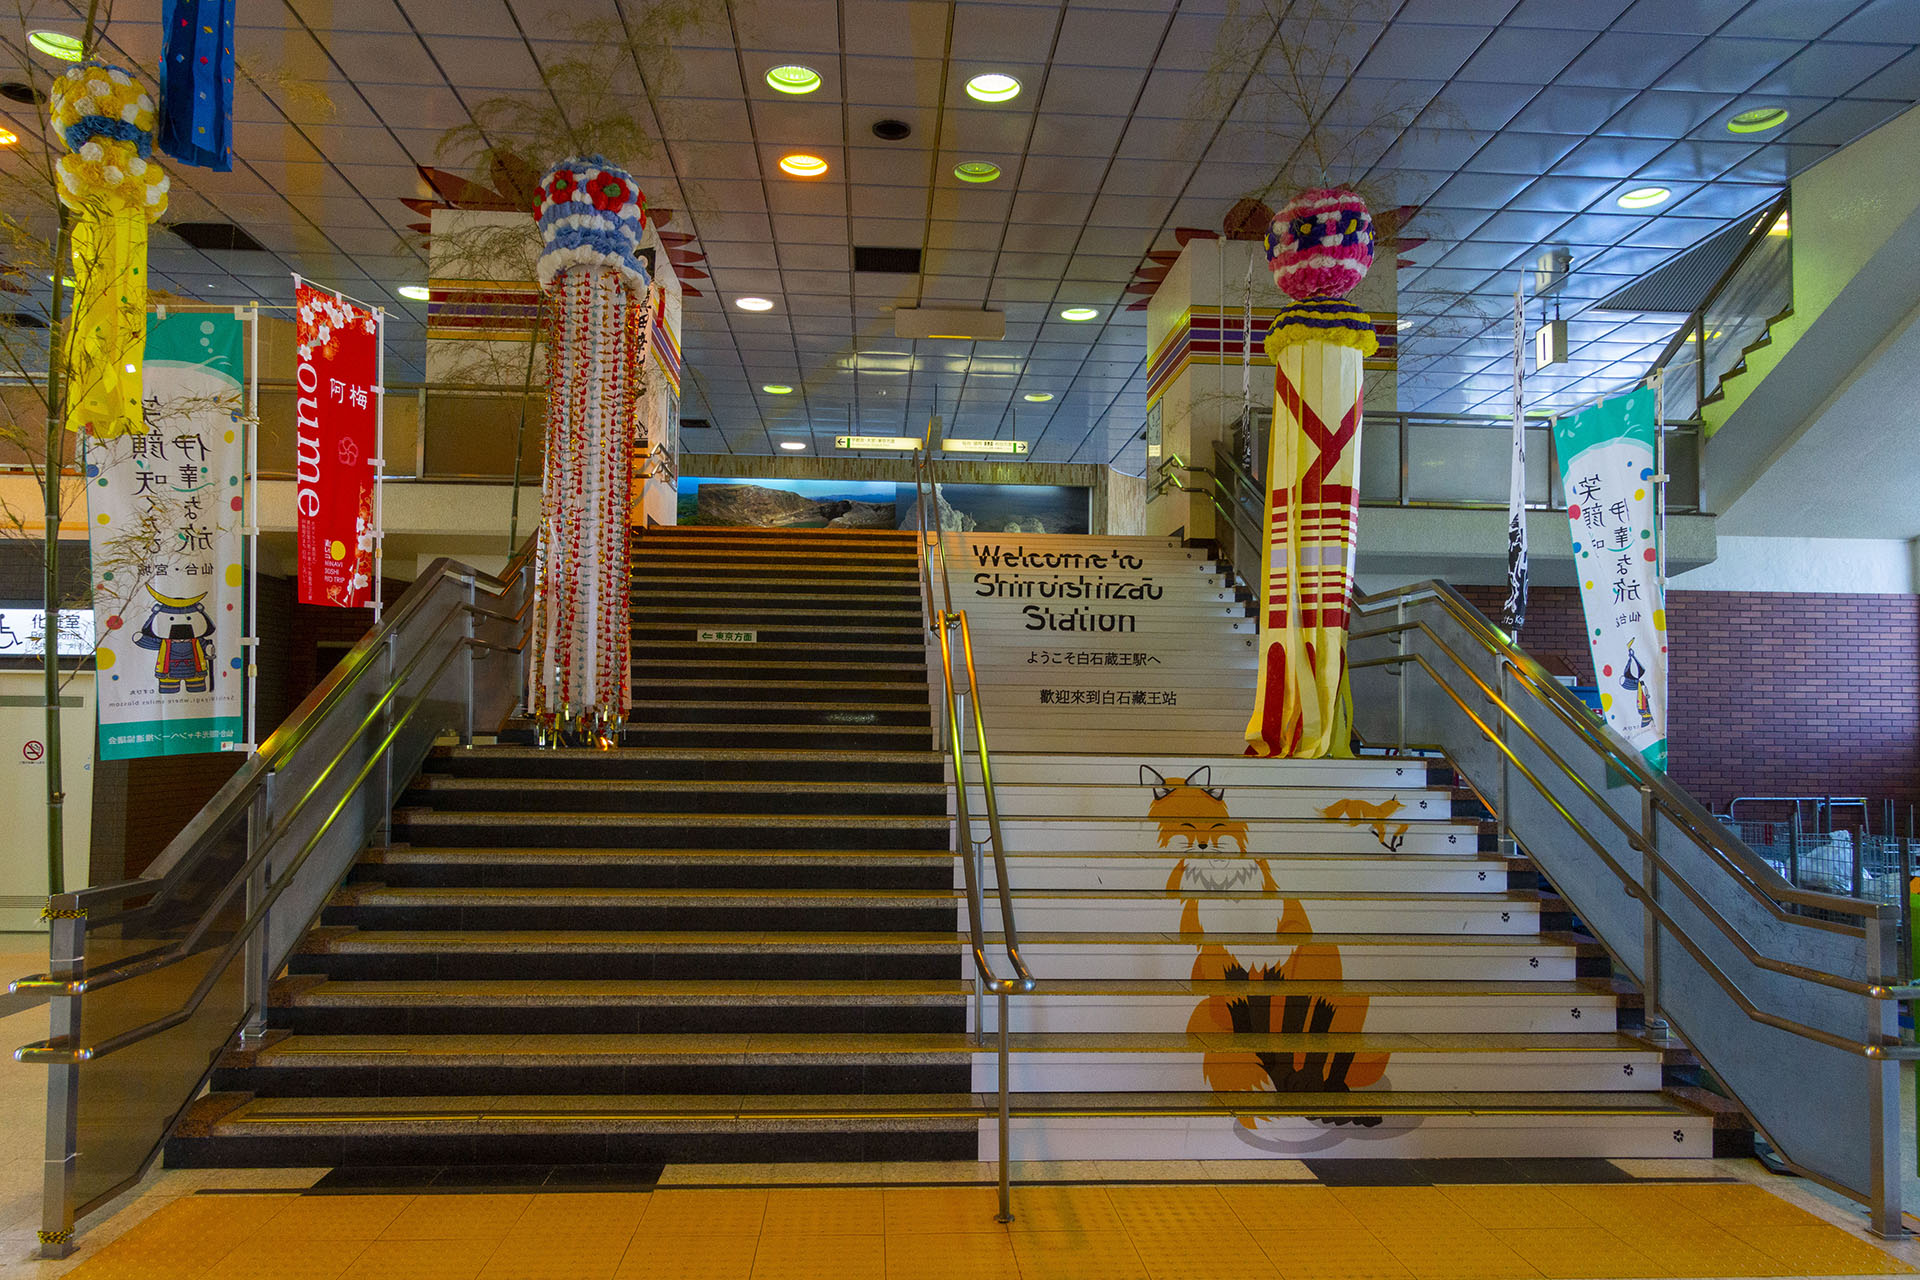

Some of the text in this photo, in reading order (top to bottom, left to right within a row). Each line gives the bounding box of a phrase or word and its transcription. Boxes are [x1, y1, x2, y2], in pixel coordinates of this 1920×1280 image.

[329, 377, 368, 411] 阿梅
[297, 362, 321, 518] oume
[972, 544, 1143, 570] Welcome to
[973, 572, 1164, 600] Shiroishizaō
[1022, 604, 1136, 633] Station
[715, 631, 753, 642] 東京方面
[1026, 651, 1161, 667] ようこそ白石蔵王駅へ
